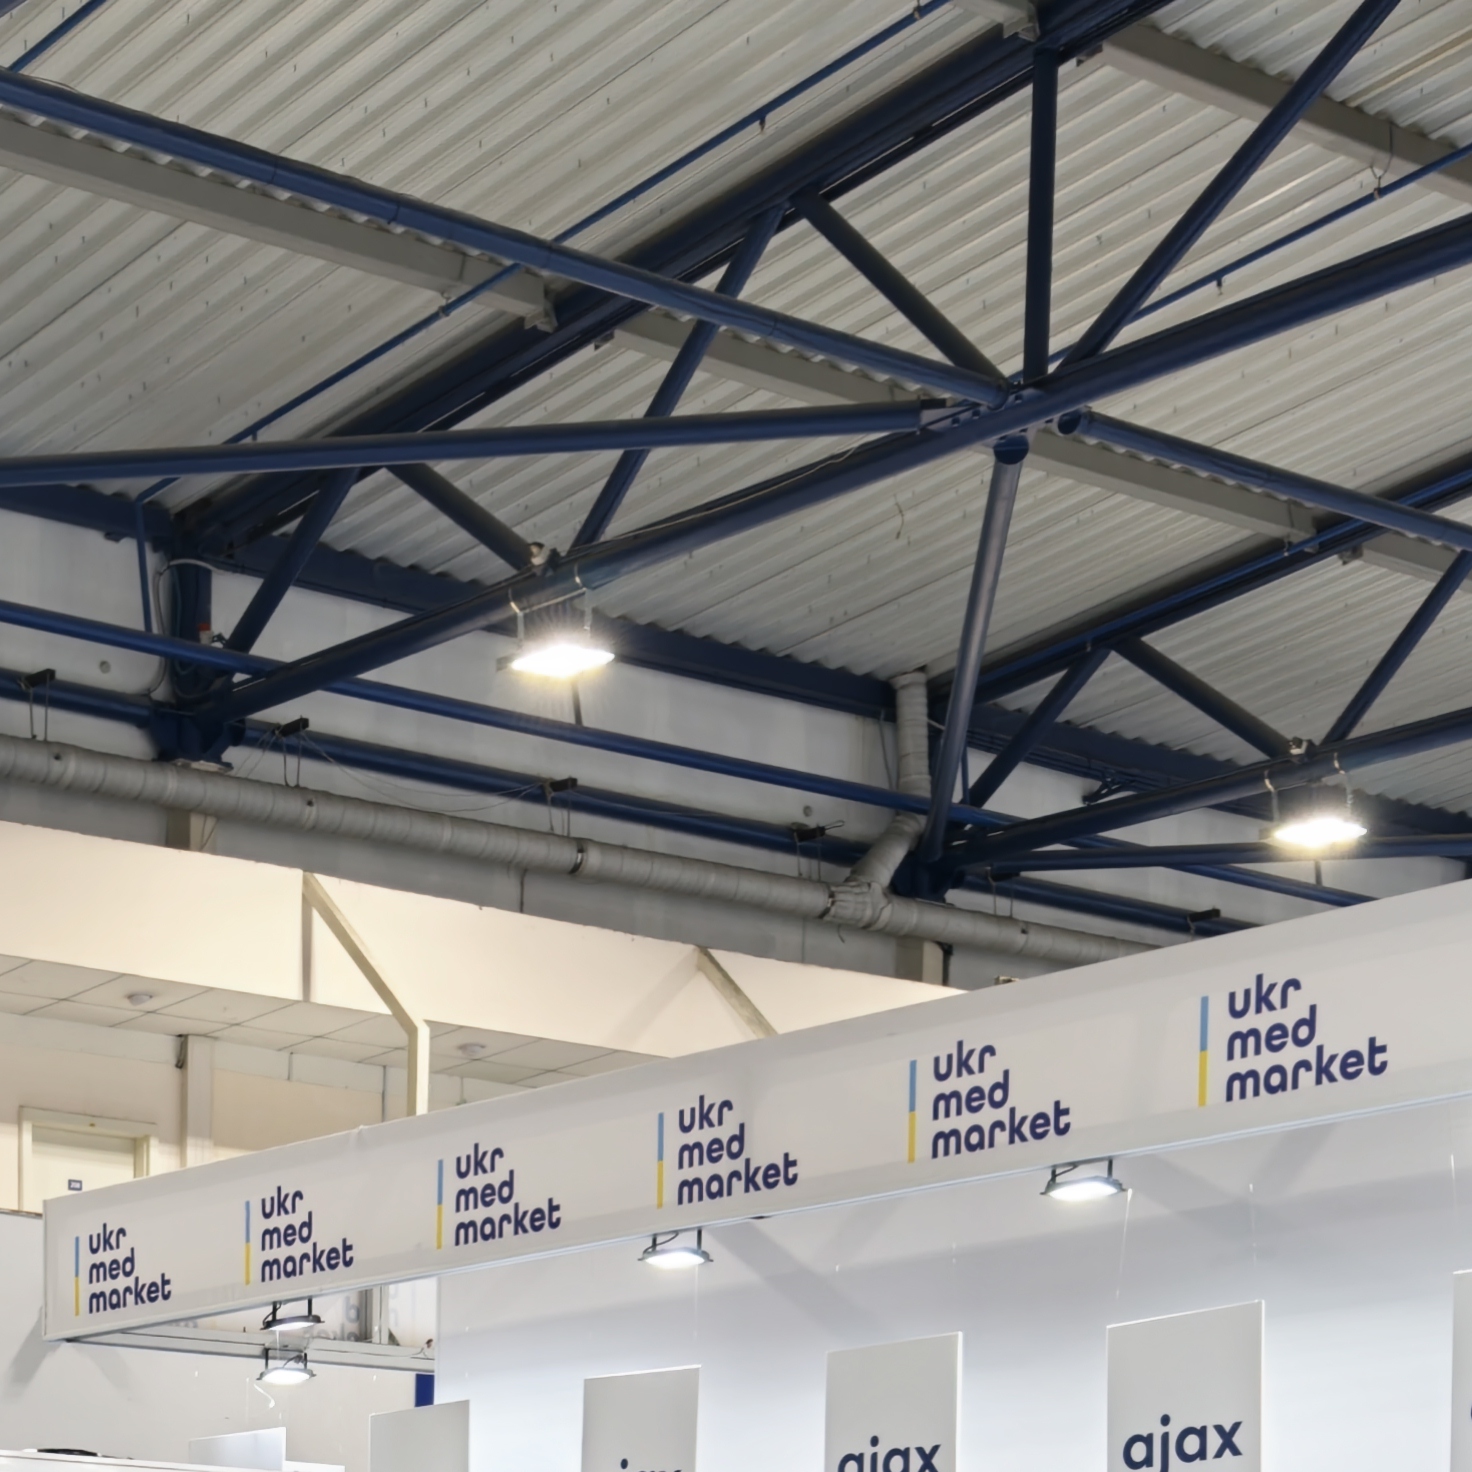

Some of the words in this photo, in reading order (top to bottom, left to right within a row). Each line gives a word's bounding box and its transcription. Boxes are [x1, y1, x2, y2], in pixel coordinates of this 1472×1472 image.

[1229, 974, 1301, 1019] ukr
[1227, 1004, 1316, 1061] med
[934, 1040, 996, 1081] ukr
[1226, 1037, 1387, 1102] market
[679, 1095, 733, 1133] ukr
[933, 1069, 1009, 1120] med
[678, 1123, 745, 1169] med
[932, 1100, 1070, 1159] market
[456, 1143, 504, 1179] ukr
[678, 1153, 798, 1205] market
[262, 1186, 303, 1219] ukr
[456, 1170, 514, 1212] med
[89, 1223, 126, 1254] ukr
[262, 1211, 312, 1251] med
[455, 1198, 561, 1246] market
[89, 1247, 135, 1284] med
[261, 1238, 353, 1282] market
[89, 1273, 171, 1314] market
